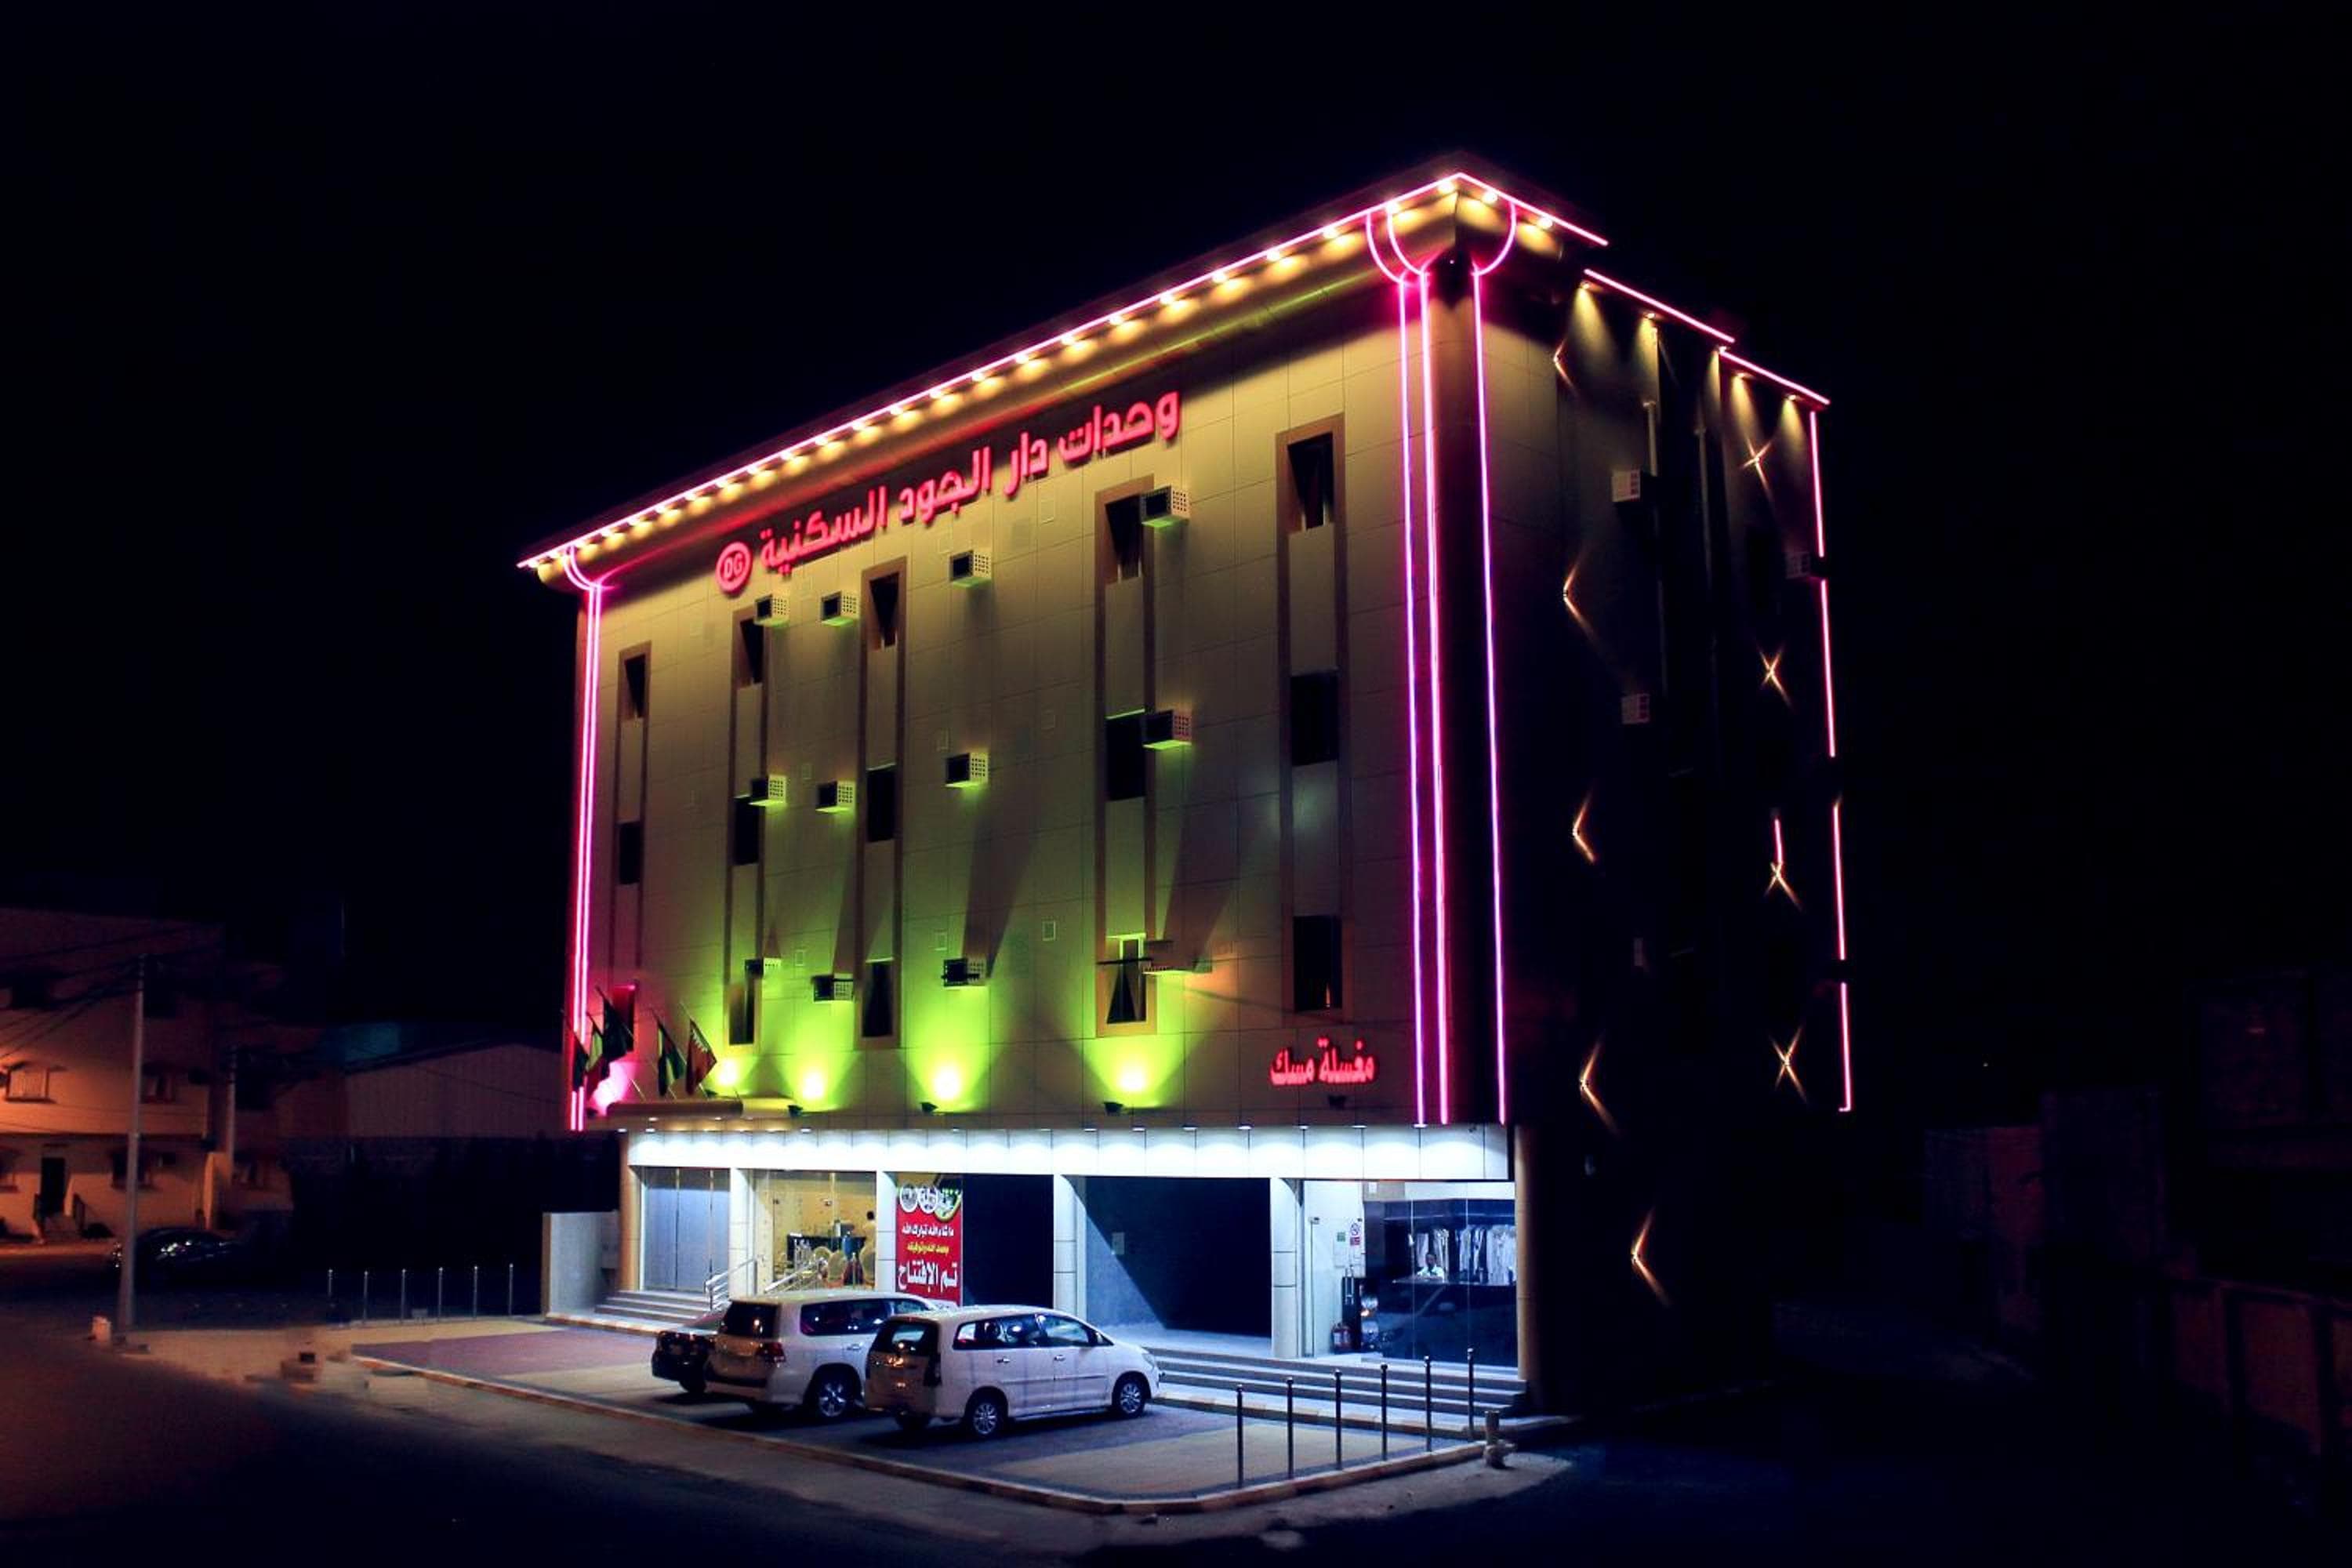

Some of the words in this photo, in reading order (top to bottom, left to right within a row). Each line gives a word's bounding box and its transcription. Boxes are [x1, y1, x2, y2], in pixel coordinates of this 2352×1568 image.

[1058, 390, 1180, 463] وحدات
[898, 446, 991, 524] الجود
[1004, 431, 1049, 498] دار
[759, 485, 888, 575] السكنية
[1270, 1047, 1315, 1085] مسك
[1317, 1036, 1375, 1083] مغسلة
[940, 1261, 958, 1293] تم
